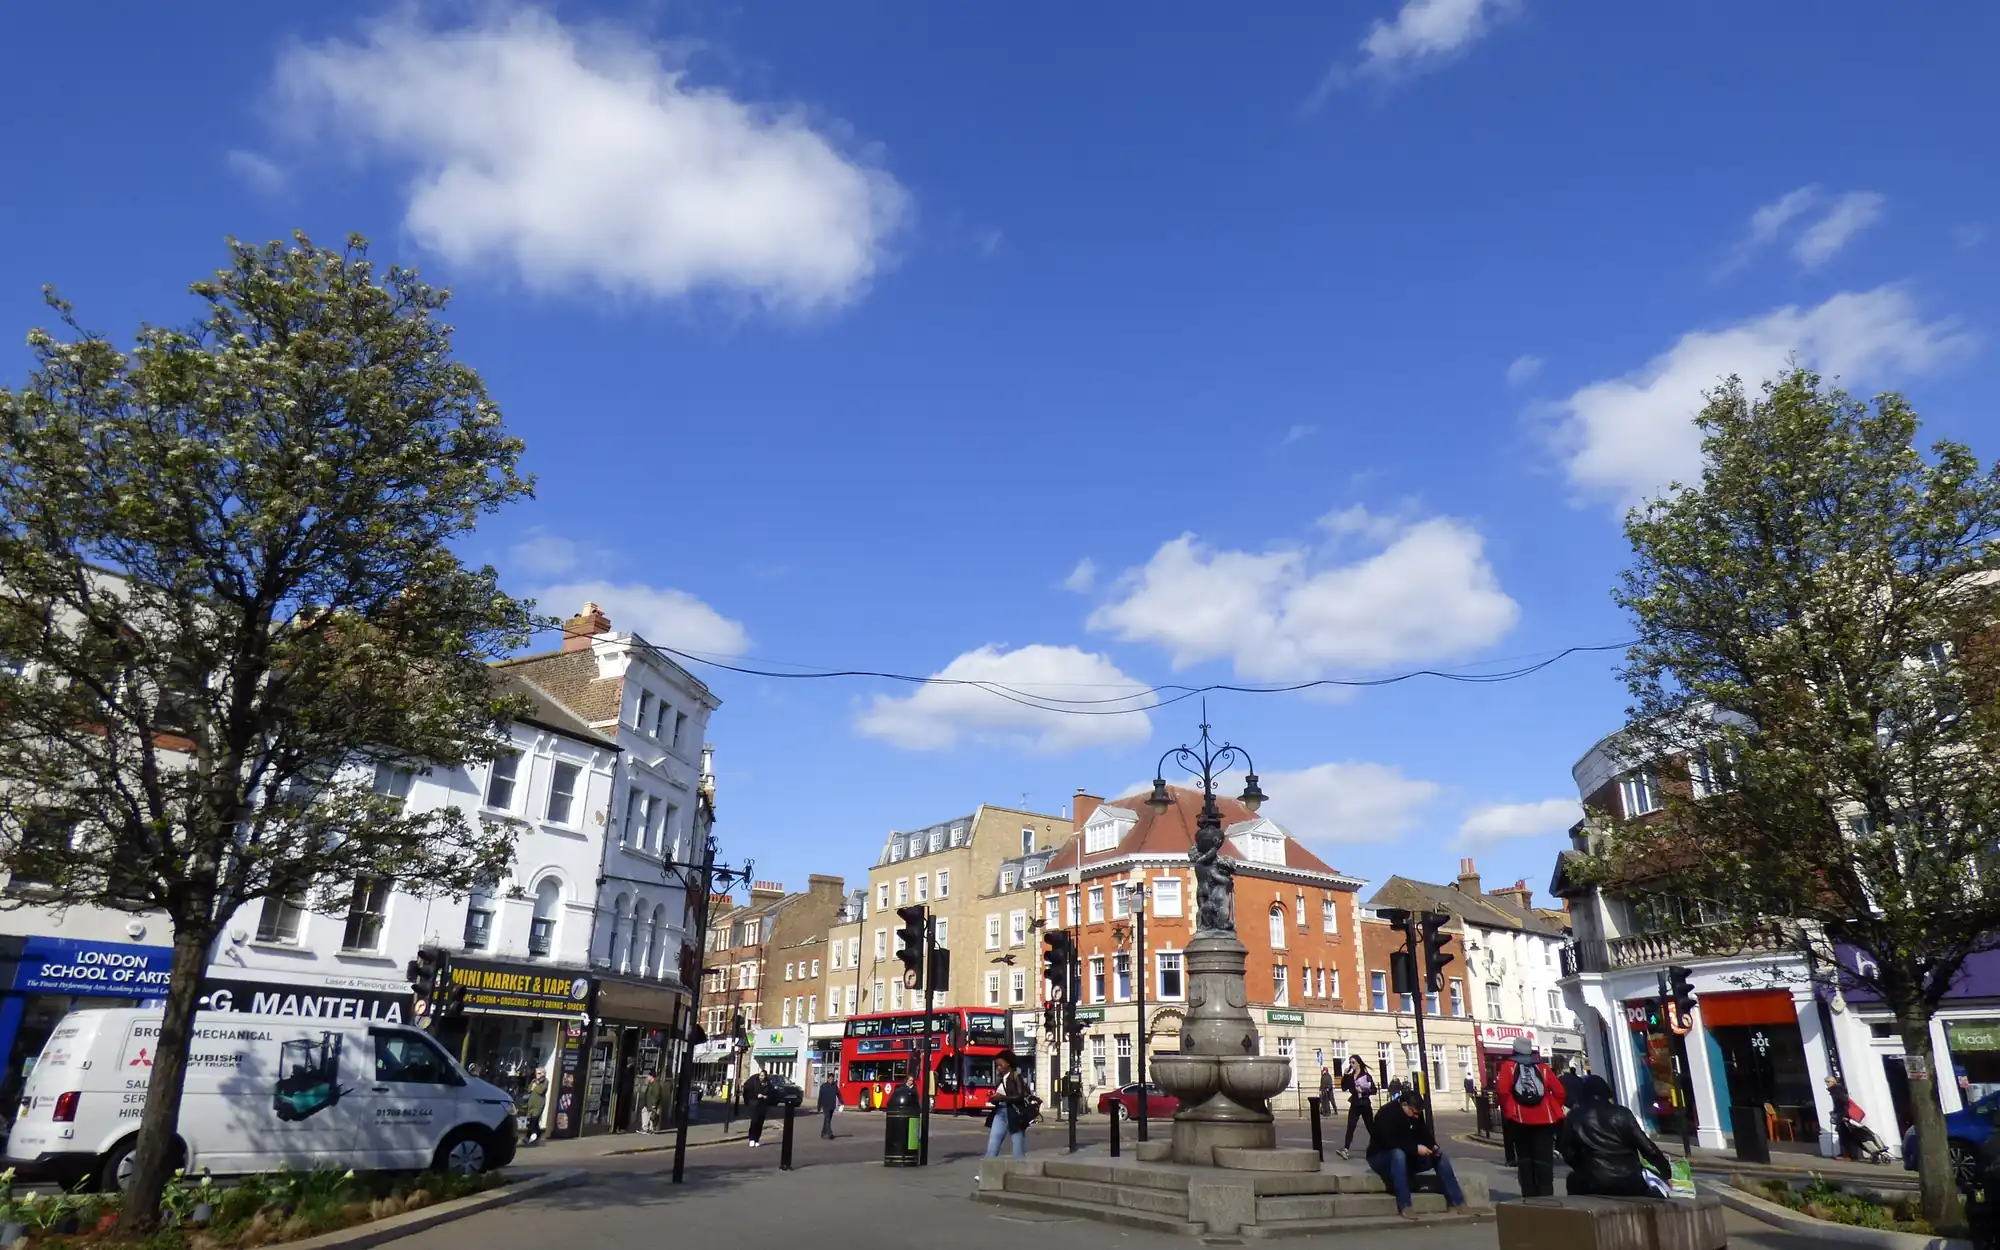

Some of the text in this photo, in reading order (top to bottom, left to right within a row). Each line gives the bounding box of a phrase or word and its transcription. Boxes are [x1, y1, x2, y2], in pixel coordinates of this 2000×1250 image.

[76, 951, 148, 968] LONDON
[40, 964, 171, 985] SCHOOL OF ARTS
[453, 968, 571, 996] MINI MARKET & VAPE
[325, 978, 347, 986] Laser
[348, 979, 355, 987] &
[251, 991, 403, 1024] MANTELLA
[134, 1027, 273, 1041] BRO MECHANICAL
[1958, 1033, 1993, 1045] haart
[126, 1080, 150, 1089] SAL
